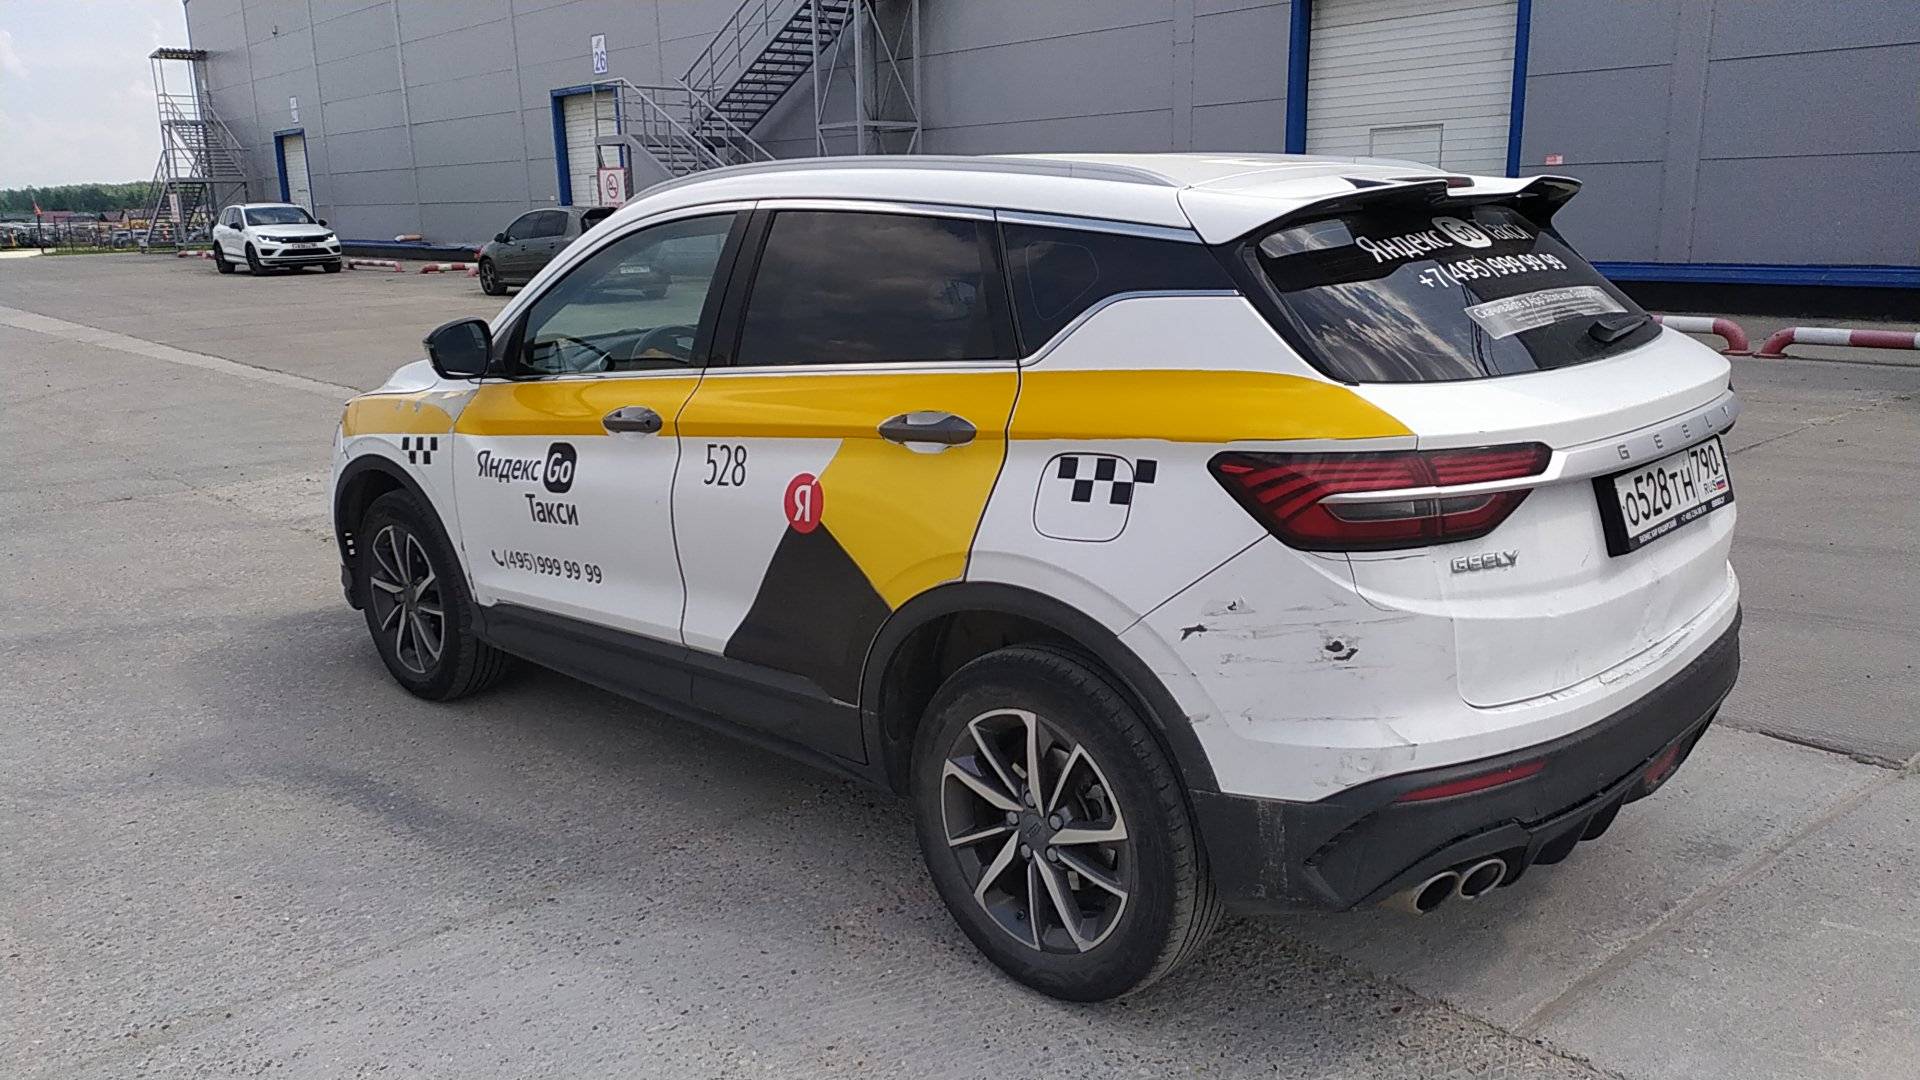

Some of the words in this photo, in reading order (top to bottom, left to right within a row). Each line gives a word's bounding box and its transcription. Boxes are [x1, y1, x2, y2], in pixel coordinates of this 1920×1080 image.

[593, 51, 606, 72] 26
[1355, 228, 1453, 263] Яндекс
[1467, 218, 1534, 241] Такси
[1617, 405, 1730, 460] GEELY
[477, 450, 542, 483] Яндекс
[703, 444, 747, 487] 528
[1691, 445, 1719, 482] 790
[1703, 480, 1717, 495] RUS
[525, 494, 579, 526] Такси
[564, 560, 581, 580] 99
[585, 563, 603, 584] 99
[1451, 550, 1520, 574] GEELY
